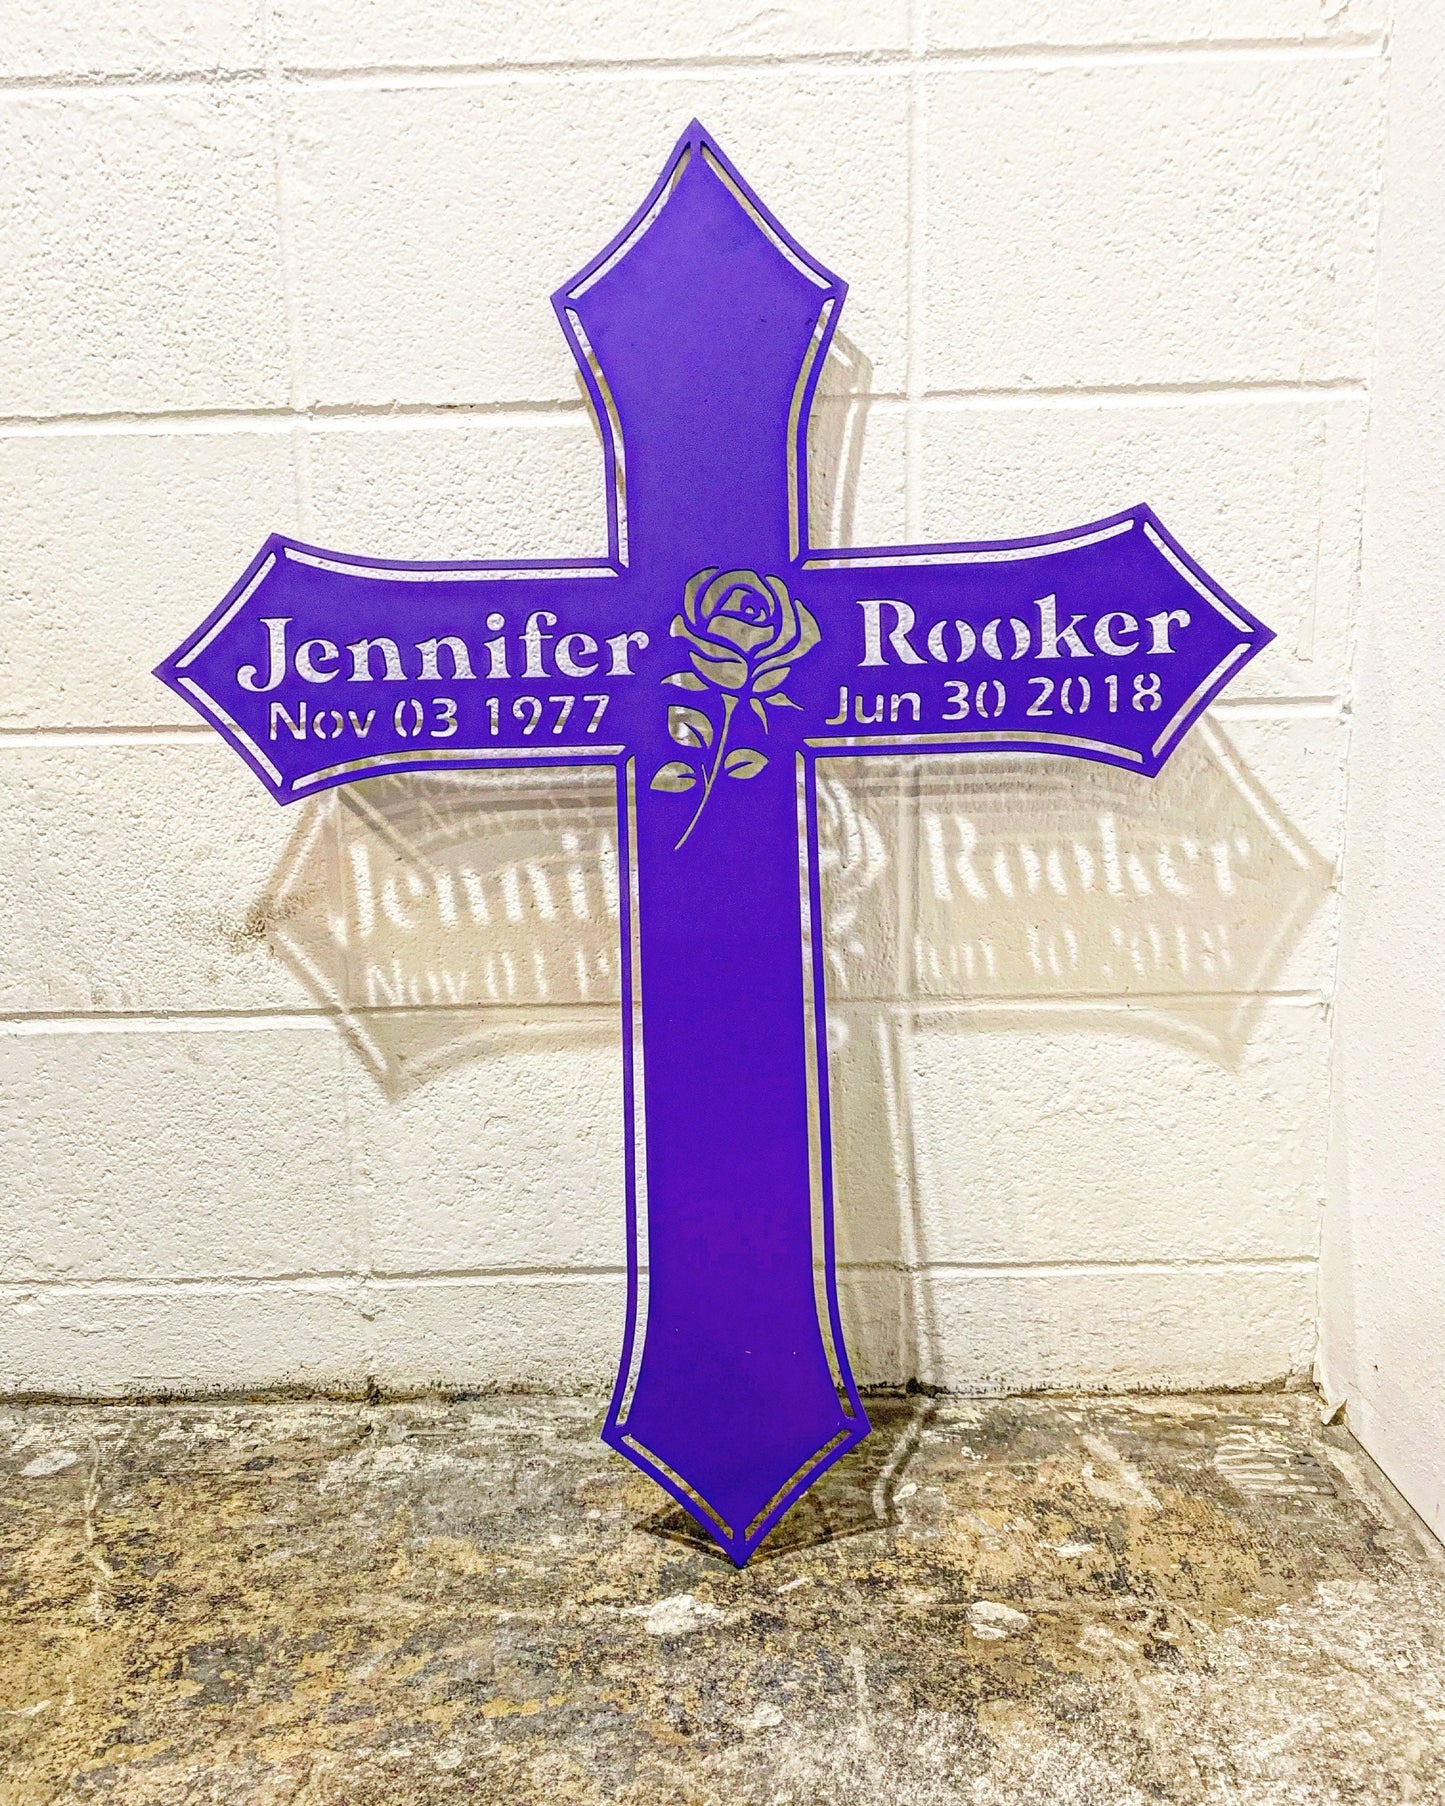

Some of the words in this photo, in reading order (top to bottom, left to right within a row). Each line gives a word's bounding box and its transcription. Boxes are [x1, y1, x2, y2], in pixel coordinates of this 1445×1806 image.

[236, 611, 651, 692] Jennifer
[855, 593, 1192, 667] Rooker
[269, 701, 377, 741] Nov
[394, 697, 458, 738] 03
[485, 694, 611, 736] 1977
[825, 686, 921, 726] Jun
[941, 679, 1007, 720] 30
[1026, 672, 1163, 716] 2018
